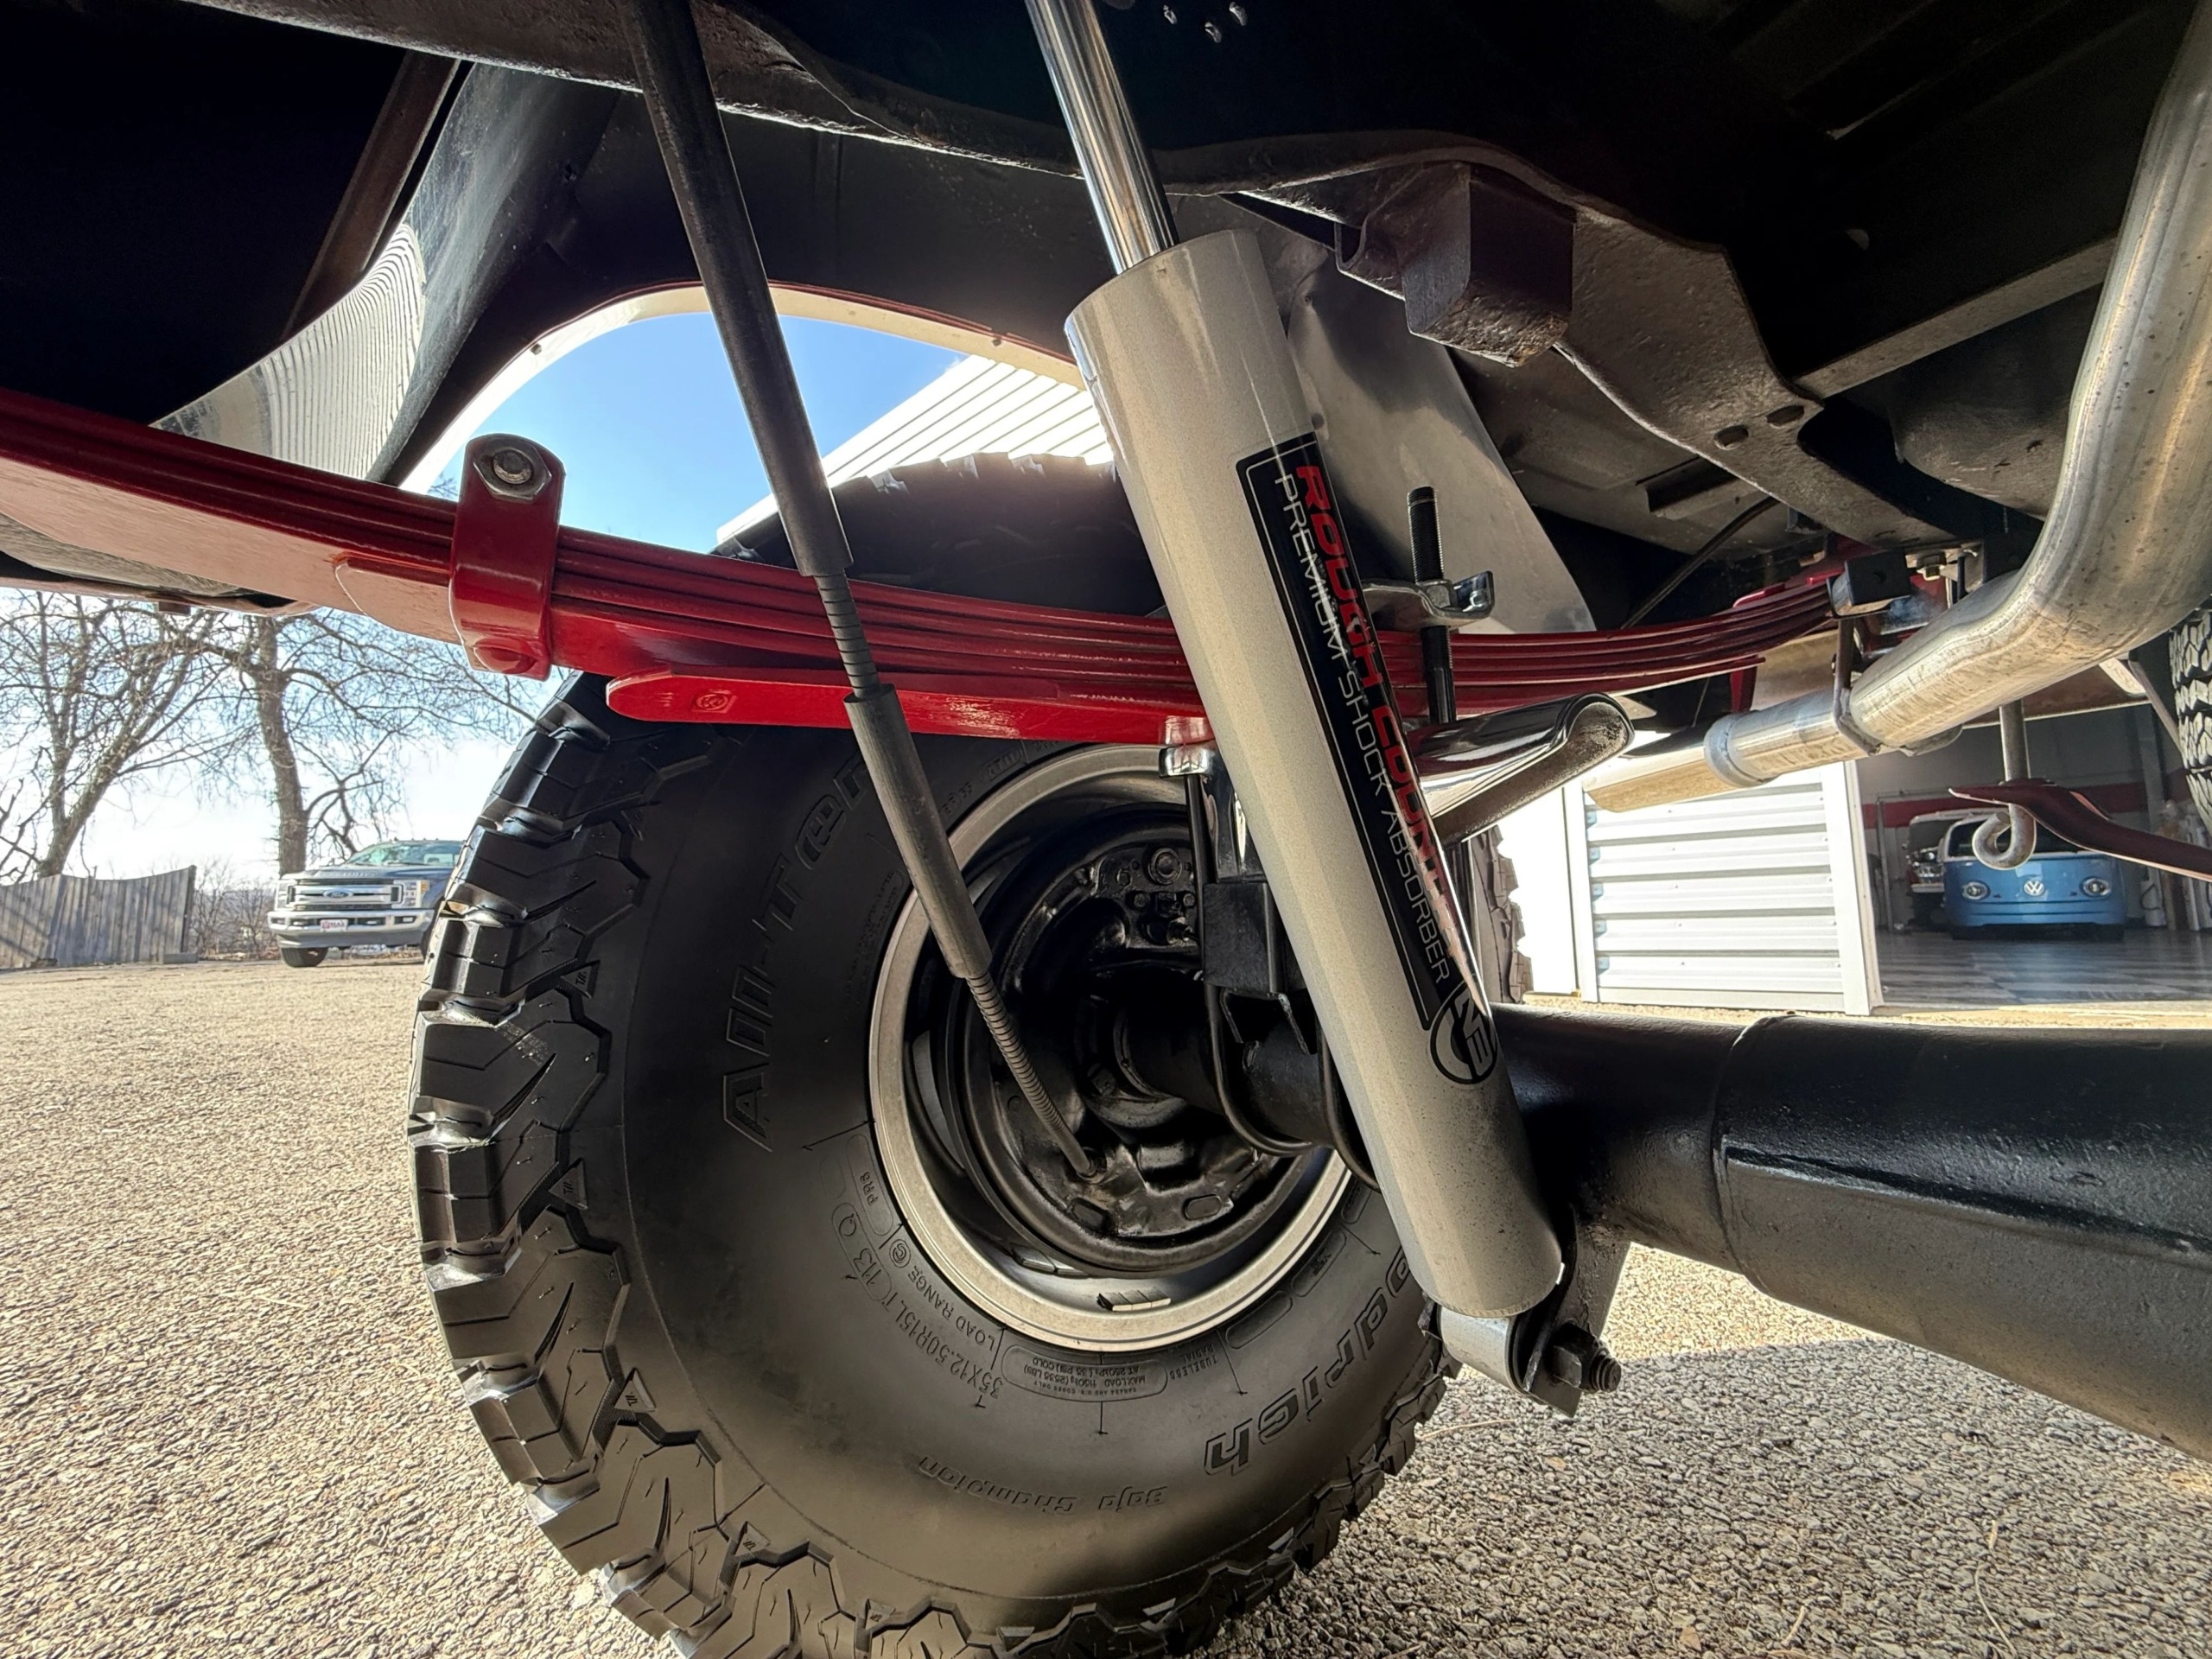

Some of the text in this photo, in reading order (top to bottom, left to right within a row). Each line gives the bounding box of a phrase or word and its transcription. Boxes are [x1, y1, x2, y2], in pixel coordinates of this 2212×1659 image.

[1296, 466, 1382, 688] ROUGH
[1274, 474, 1450, 984] PREMIUM SHOCK ABSORBER
[839, 1214, 857, 1236] Q
[853, 1248, 882, 1286] 113
[907, 1266, 955, 1320] RANGE
[956, 1315, 995, 1351] LOAD
[1032, 1357, 1055, 1371] COLD
[1169, 1354, 1217, 1380] TUBELESS
[1180, 1343, 1215, 1363] RADIAL
[918, 1456, 1167, 1515] Baja Champion
